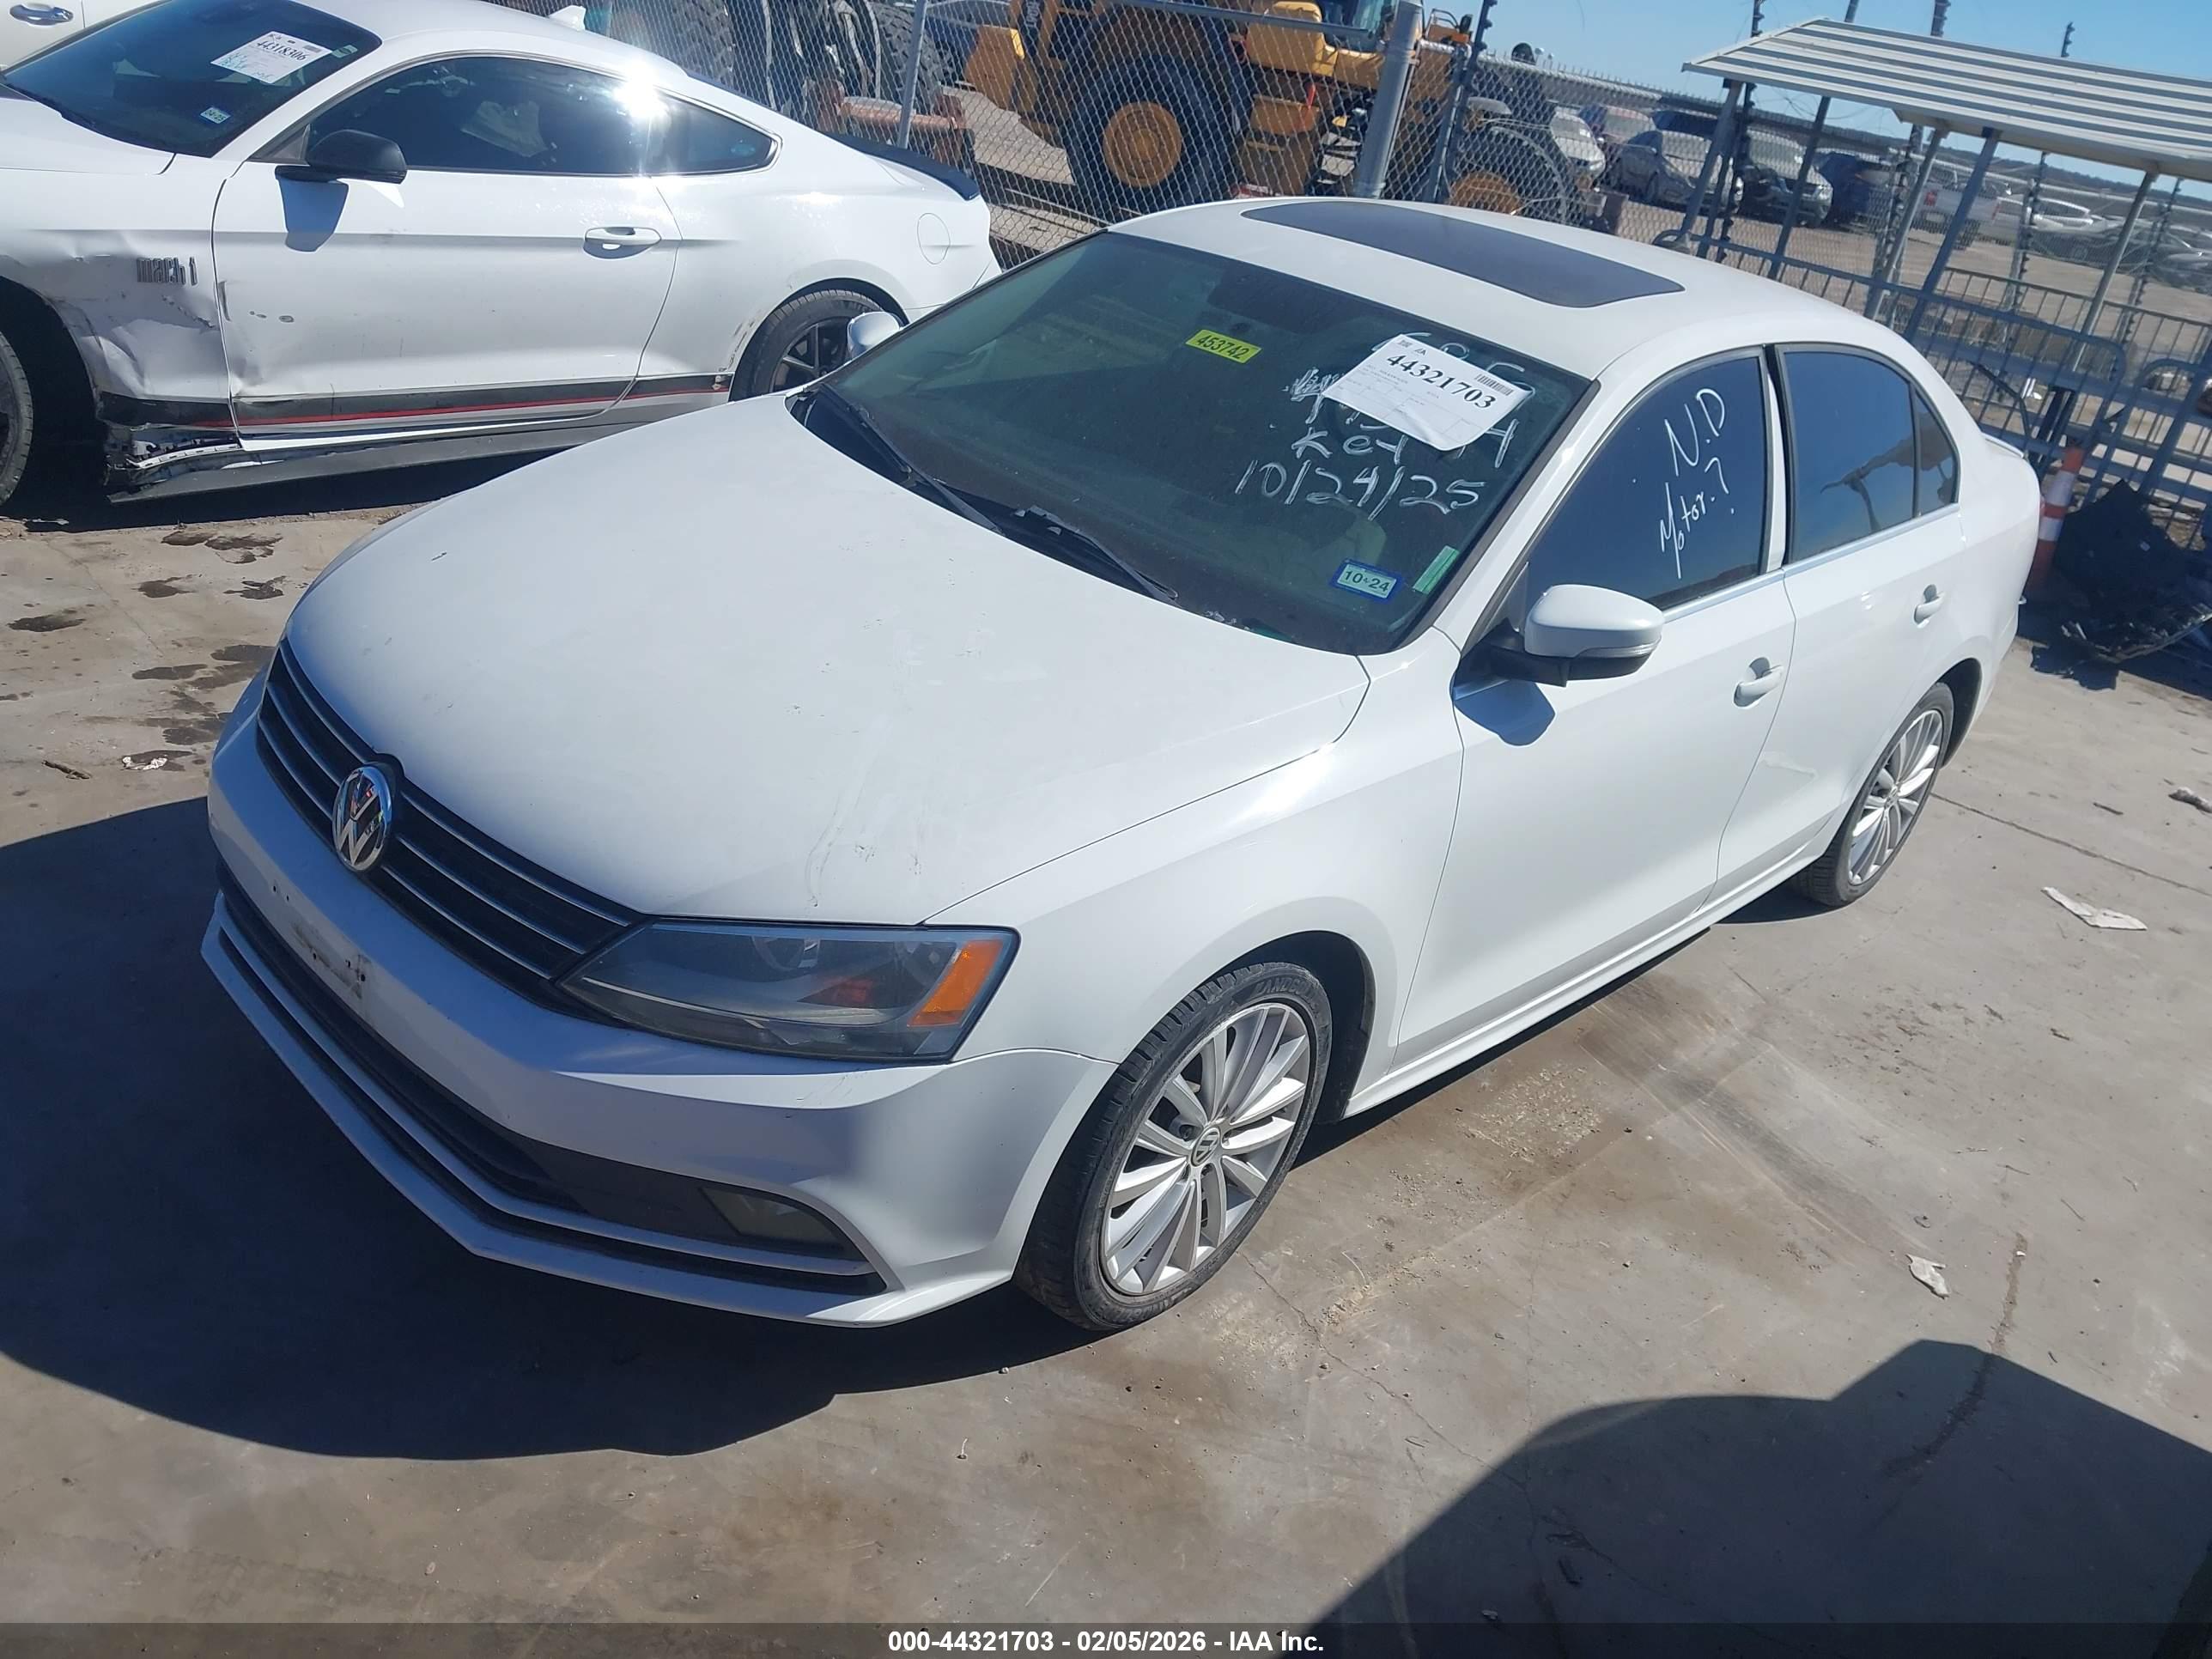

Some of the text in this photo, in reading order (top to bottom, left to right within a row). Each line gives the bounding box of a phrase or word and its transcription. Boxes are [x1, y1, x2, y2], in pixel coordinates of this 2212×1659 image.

[258, 40, 307, 61] 44318306
[1196, 335, 1249, 359] 453742
[1386, 355, 1497, 409] 44321703
